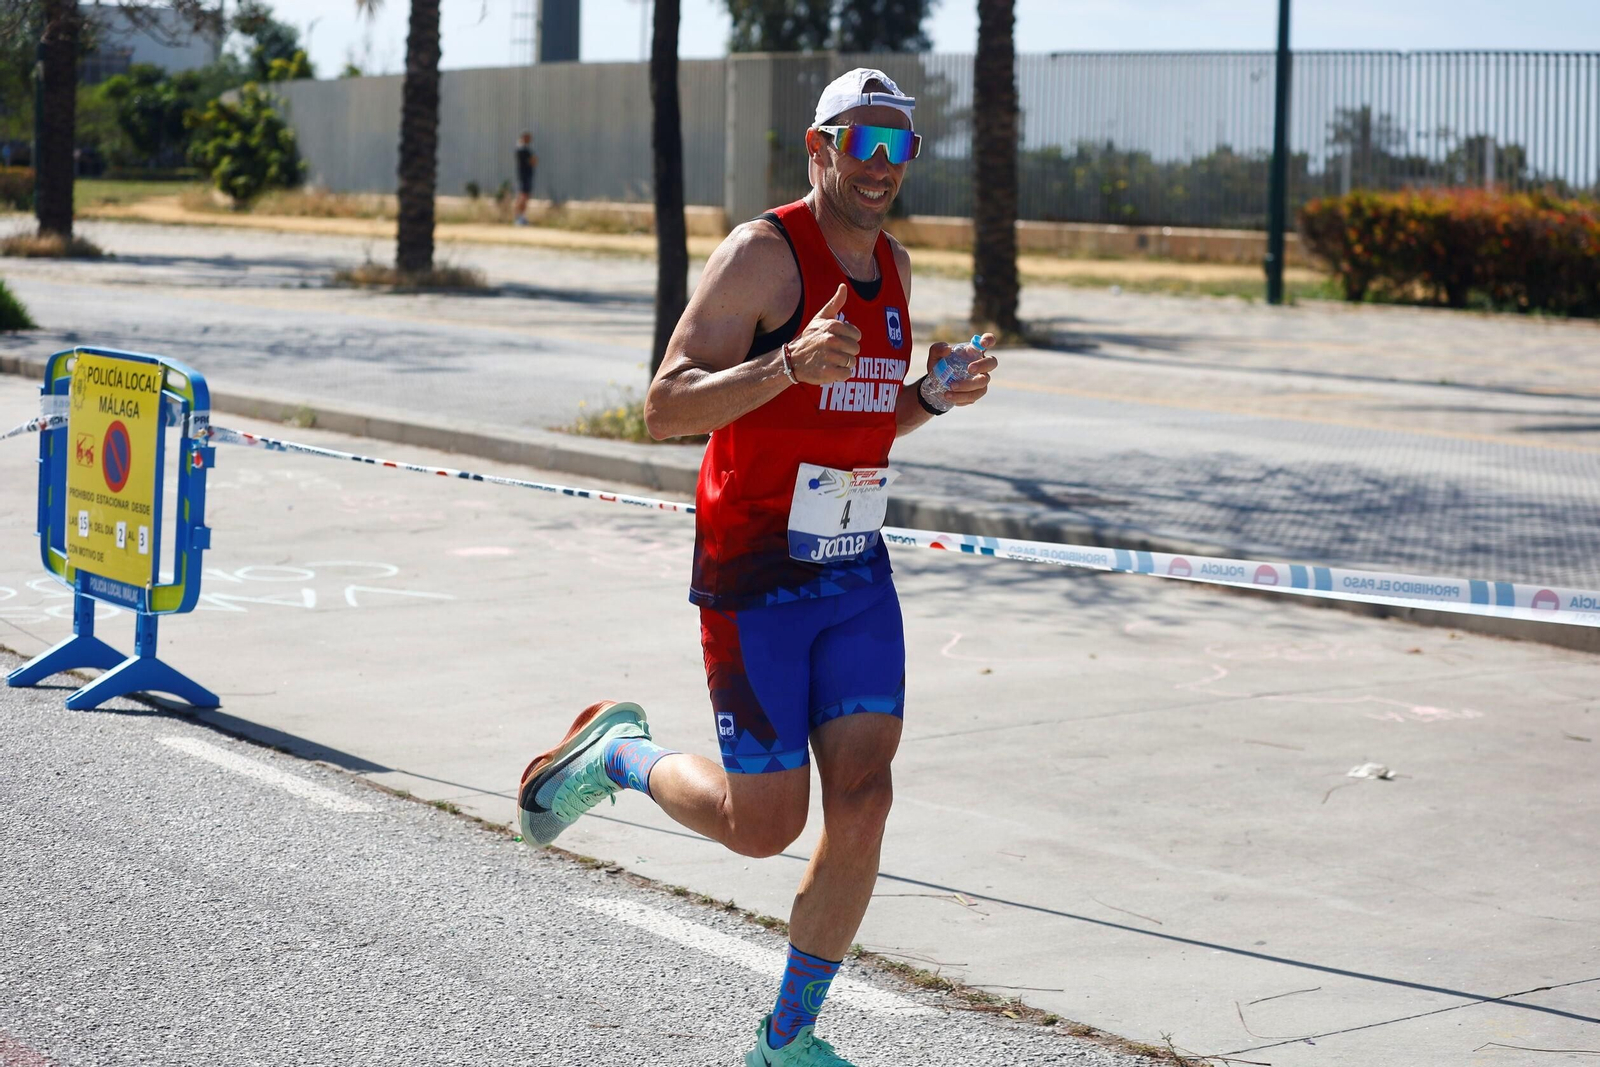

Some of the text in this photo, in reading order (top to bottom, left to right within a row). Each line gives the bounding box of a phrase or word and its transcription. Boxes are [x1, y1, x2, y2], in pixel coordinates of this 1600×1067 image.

[87, 366, 157, 393] POLICÍA LOCAL
[857, 357, 906, 381] ATLETISMO
[99, 394, 139, 419] MÁLAGA
[69, 487, 150, 515] PROHIBIDO ESTACIONAR DESDE
[840, 500, 852, 529] 4
[80, 516, 88, 530] 15
[94, 522, 104, 534] DEL
[119, 528, 123, 542] 2
[128, 531, 135, 541] AL
[140, 532, 145, 547] 3
[69, 543, 104, 563] CON MOTIVO DE
[810, 534, 866, 560] Joma
